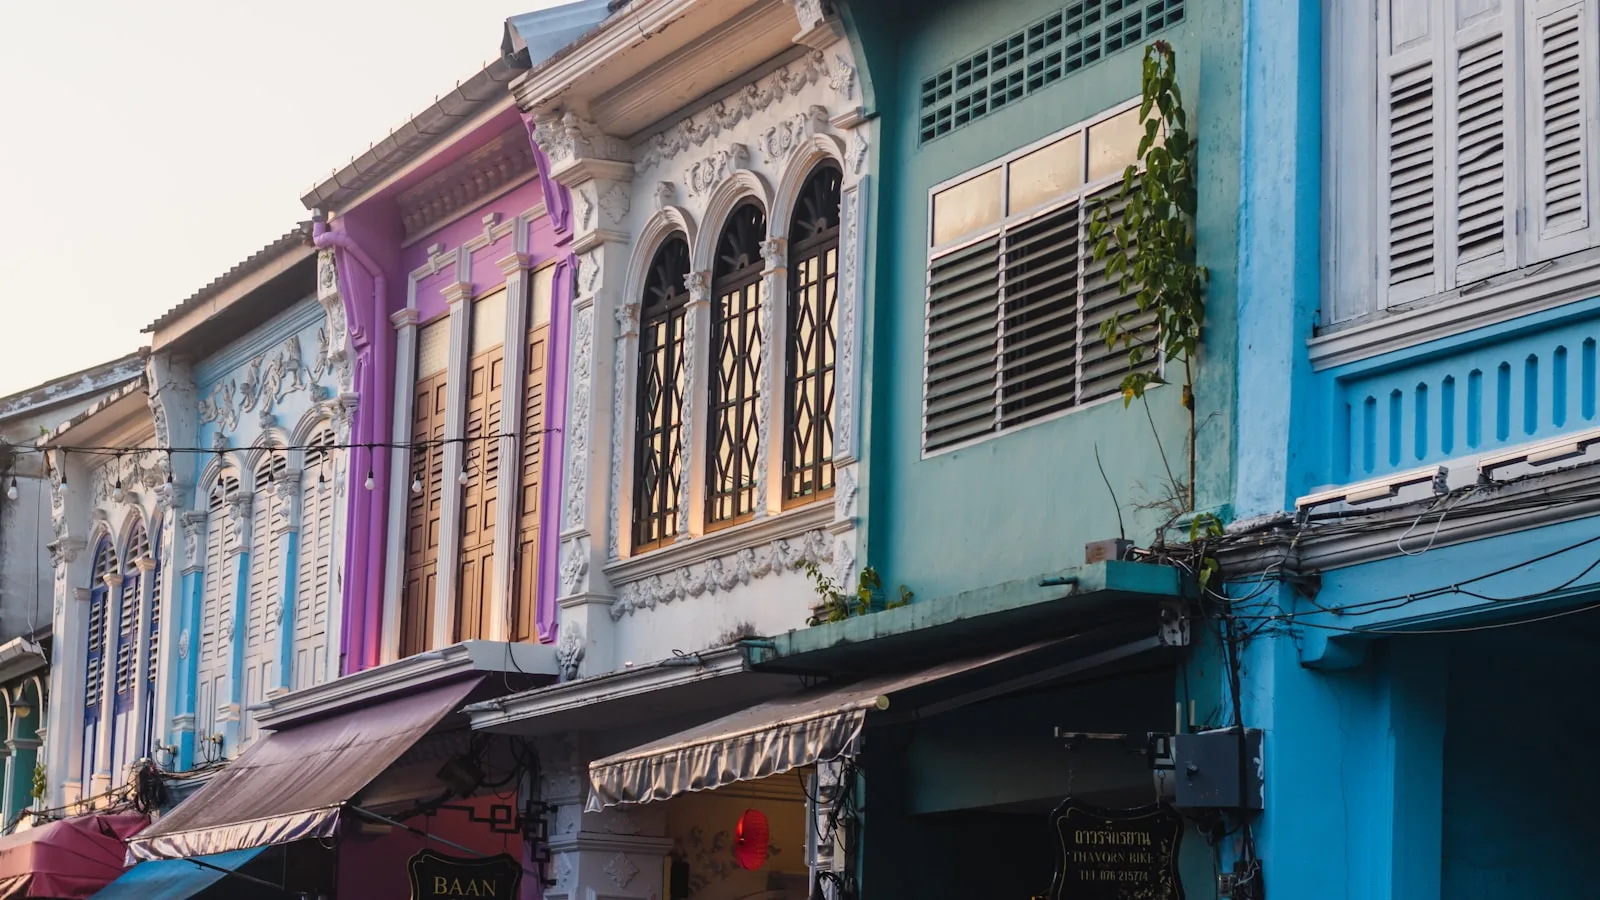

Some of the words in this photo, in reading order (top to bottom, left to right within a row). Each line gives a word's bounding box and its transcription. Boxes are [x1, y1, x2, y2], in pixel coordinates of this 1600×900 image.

[1100, 870, 1116, 881] 076
[1118, 870, 1149, 881] 215774
[433, 876, 497, 897] BAAN
